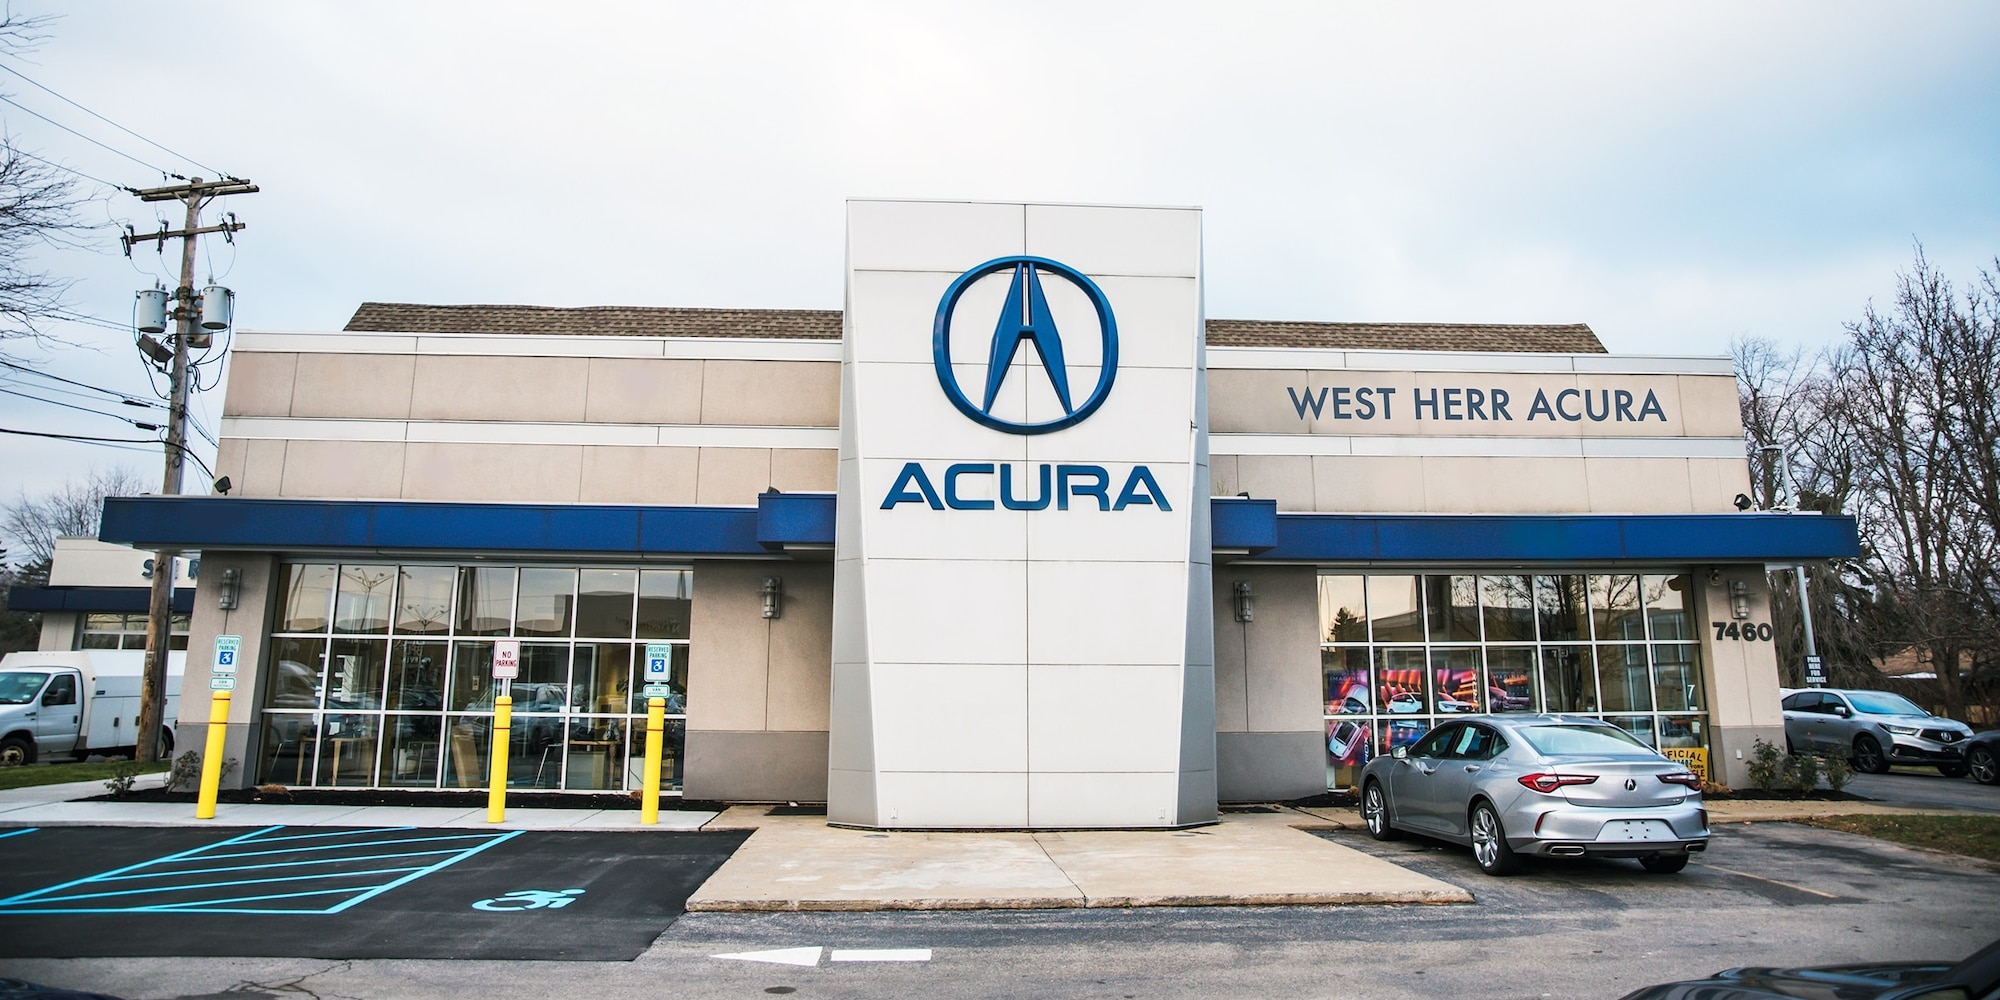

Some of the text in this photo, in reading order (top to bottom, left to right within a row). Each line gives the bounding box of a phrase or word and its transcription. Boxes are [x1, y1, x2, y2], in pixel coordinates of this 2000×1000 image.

[1287, 387, 1668, 422] WEST HERR ACURA
[879, 462, 1173, 512] ACURA
[1712, 622, 1774, 642] 7460
[496, 659, 517, 667] PARKING
[502, 651, 512, 659] NO
[1661, 750, 1702, 762] FICIAL
